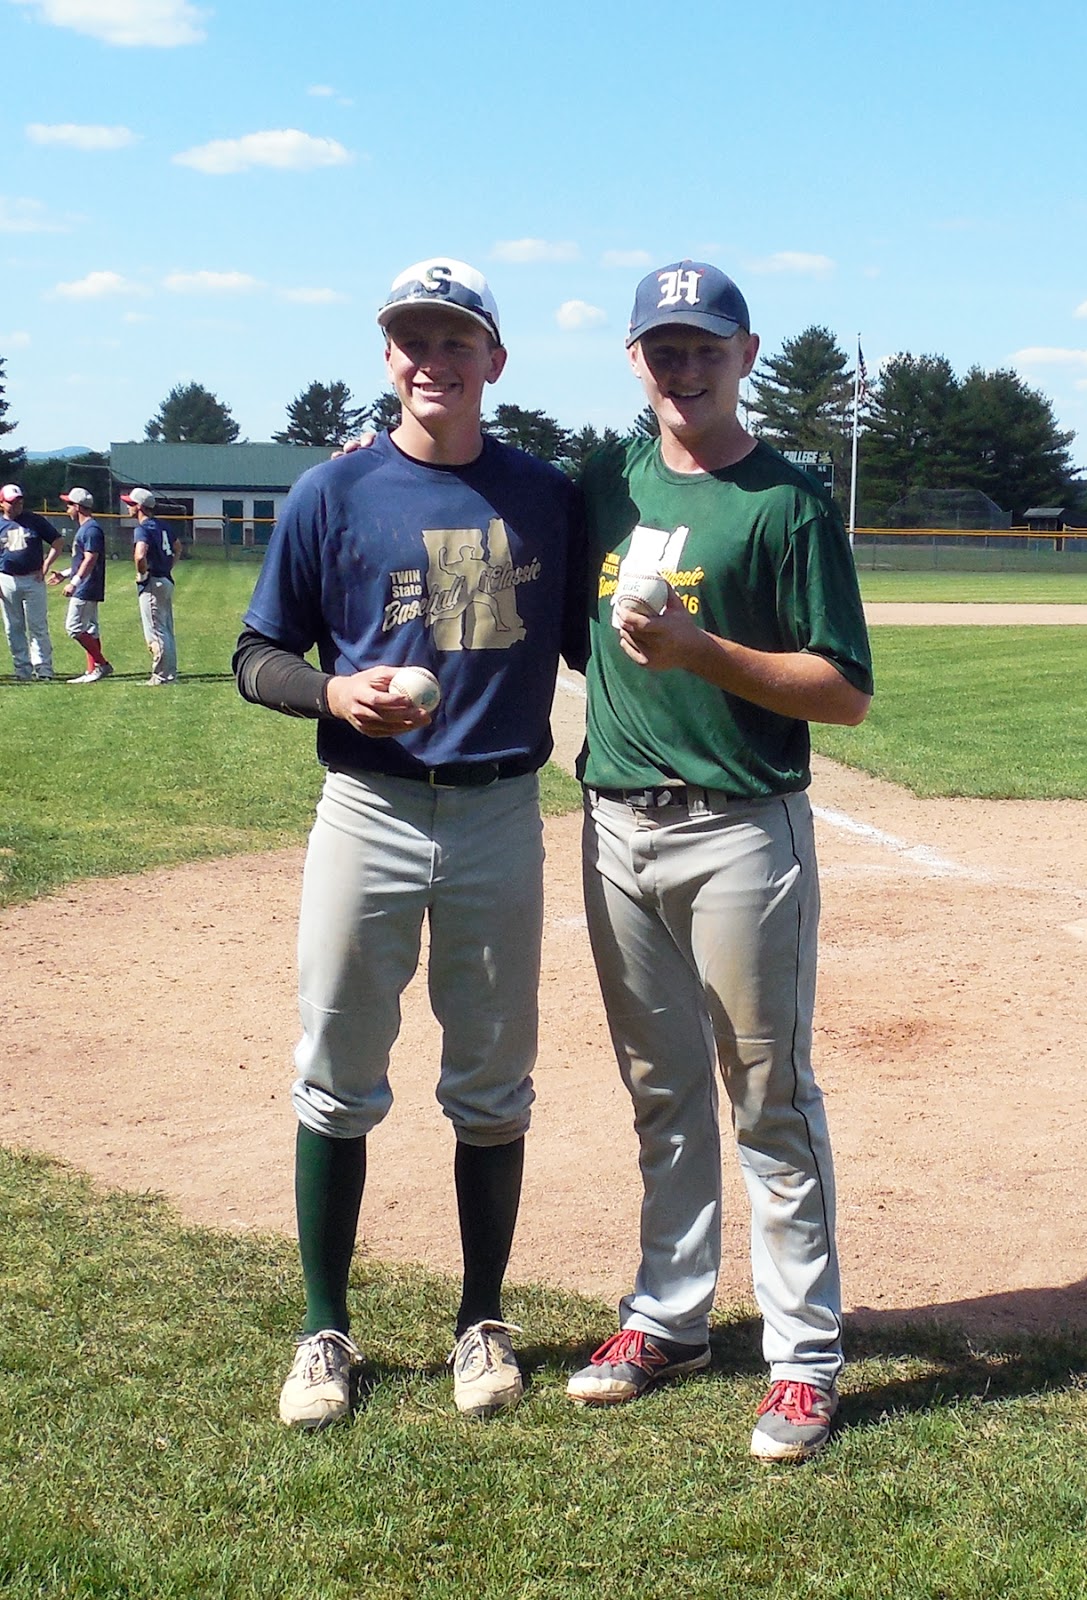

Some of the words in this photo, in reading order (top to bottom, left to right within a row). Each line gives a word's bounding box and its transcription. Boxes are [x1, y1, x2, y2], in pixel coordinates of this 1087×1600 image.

[423, 266, 452, 295] S
[656, 268, 704, 309] H
[161, 530, 173, 556] 4
[389, 569, 420, 585] TWIN
[382, 576, 465, 632] Baseball
[489, 556, 541, 593] Classic
[392, 584, 422, 599] State
